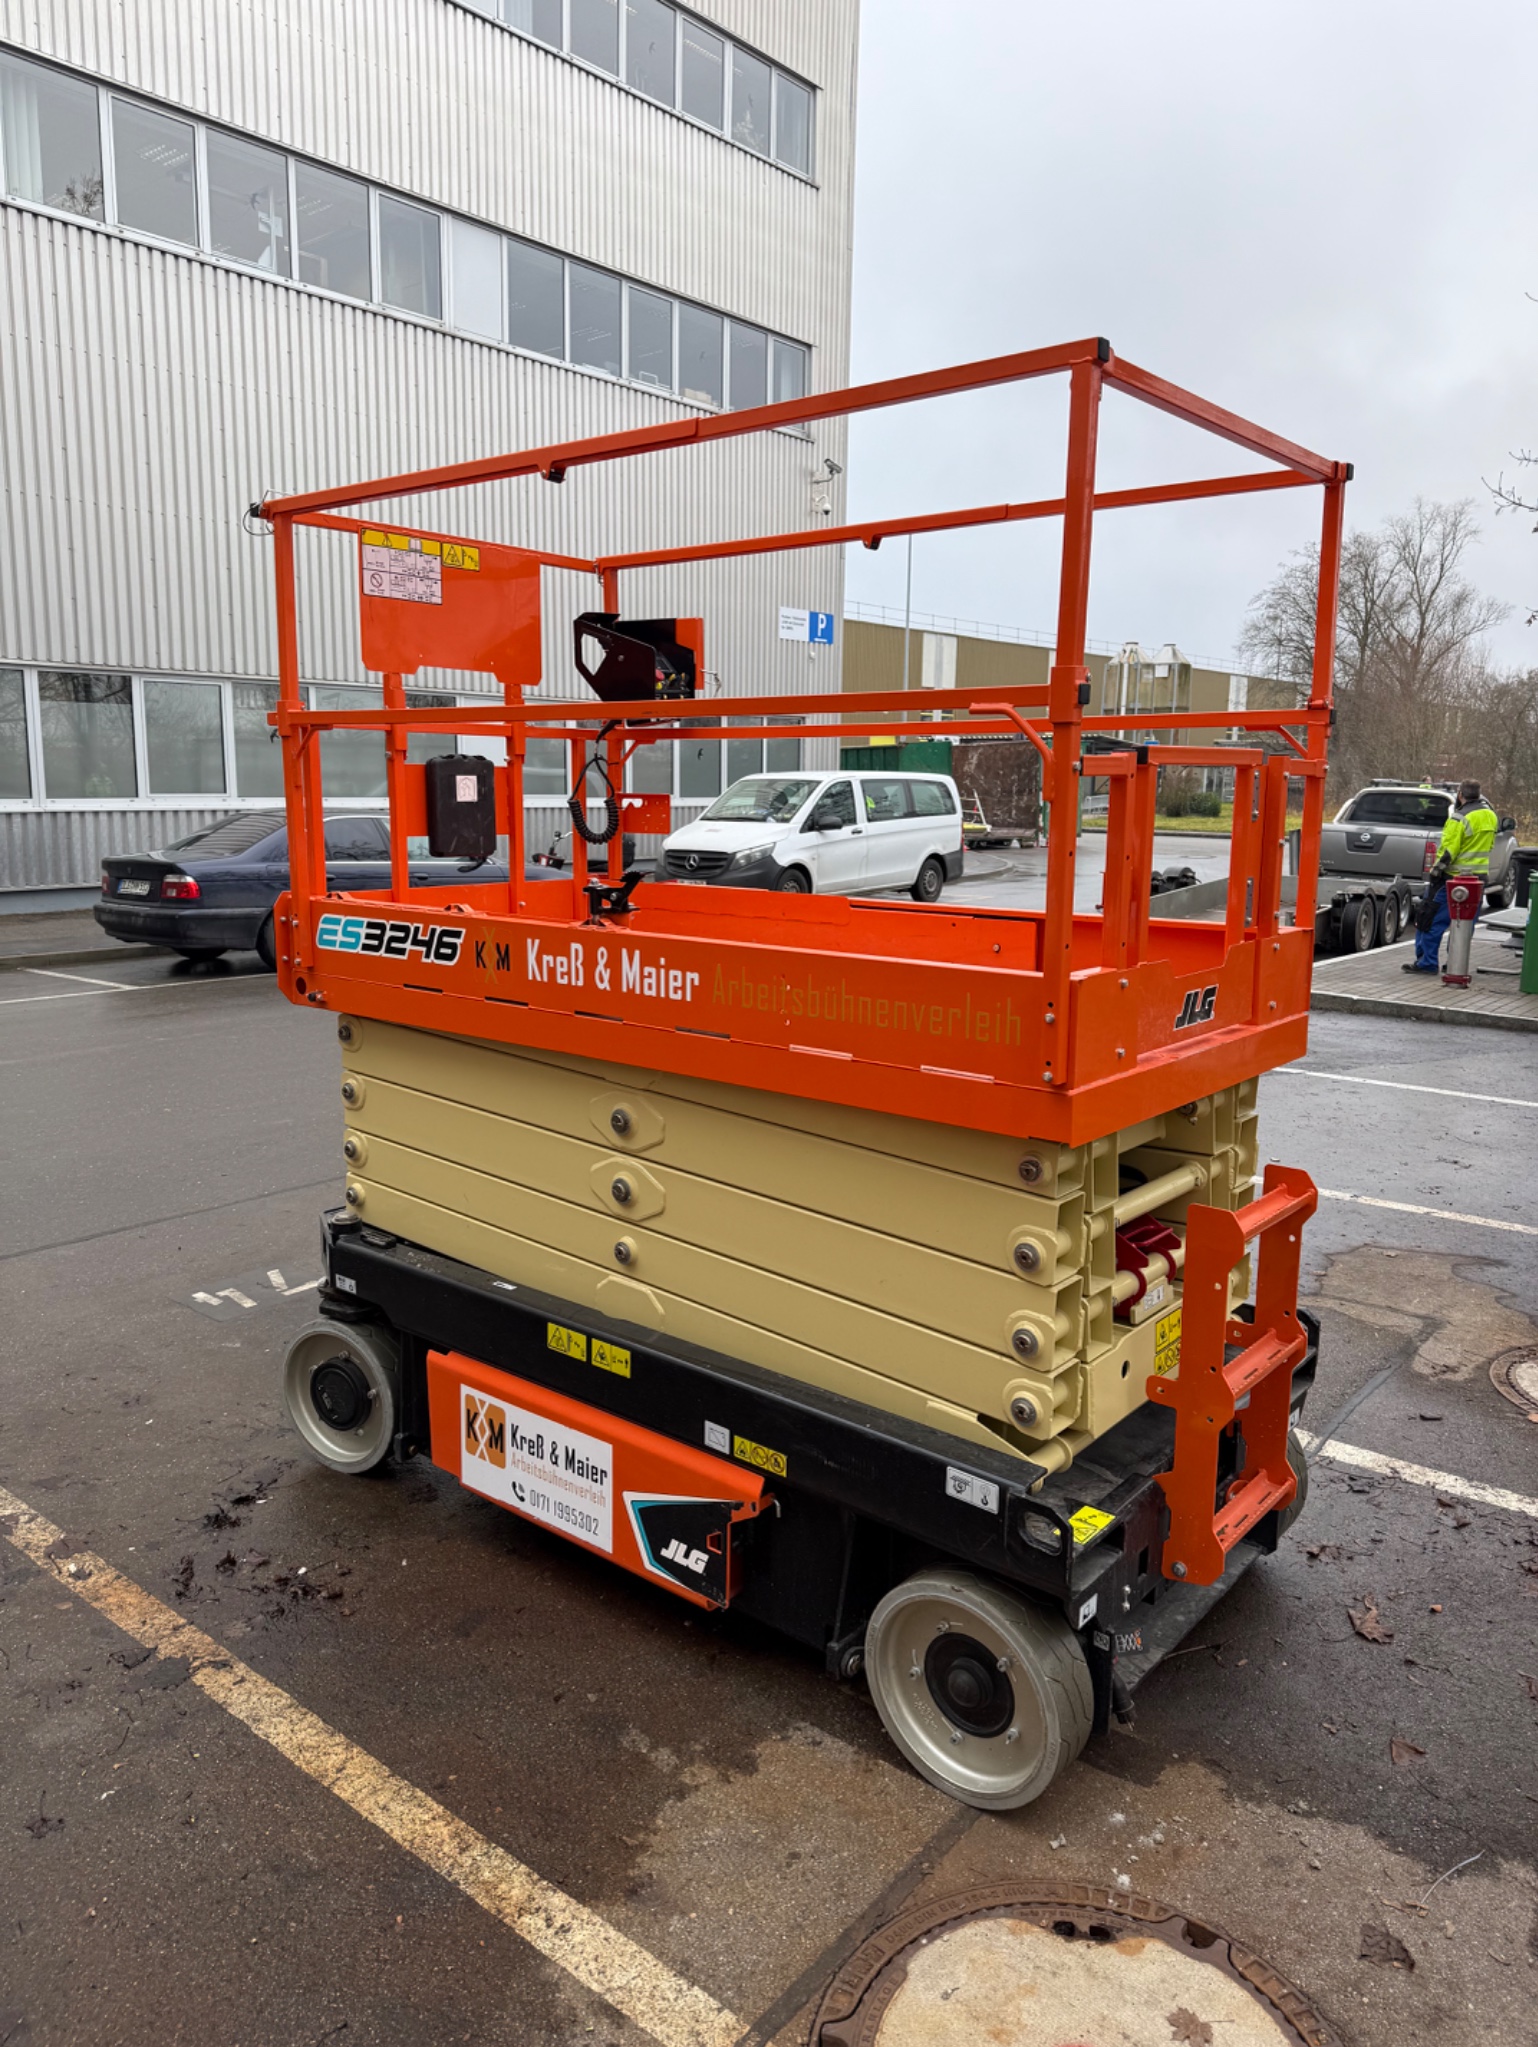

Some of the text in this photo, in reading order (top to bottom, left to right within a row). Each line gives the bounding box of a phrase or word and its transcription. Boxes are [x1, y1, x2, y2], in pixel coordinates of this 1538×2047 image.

[817, 613, 827, 637] P
[317, 914, 465, 965] ES3246
[527, 938, 1022, 1047] Kreß & Maier Arbeitsbühnenverleih
[1173, 984, 1219, 1031] JLG
[510, 1423, 608, 1486] Kreß & Maier
[529, 1489, 600, 1536] 0171 1995302
[659, 1538, 710, 1574] JLG
